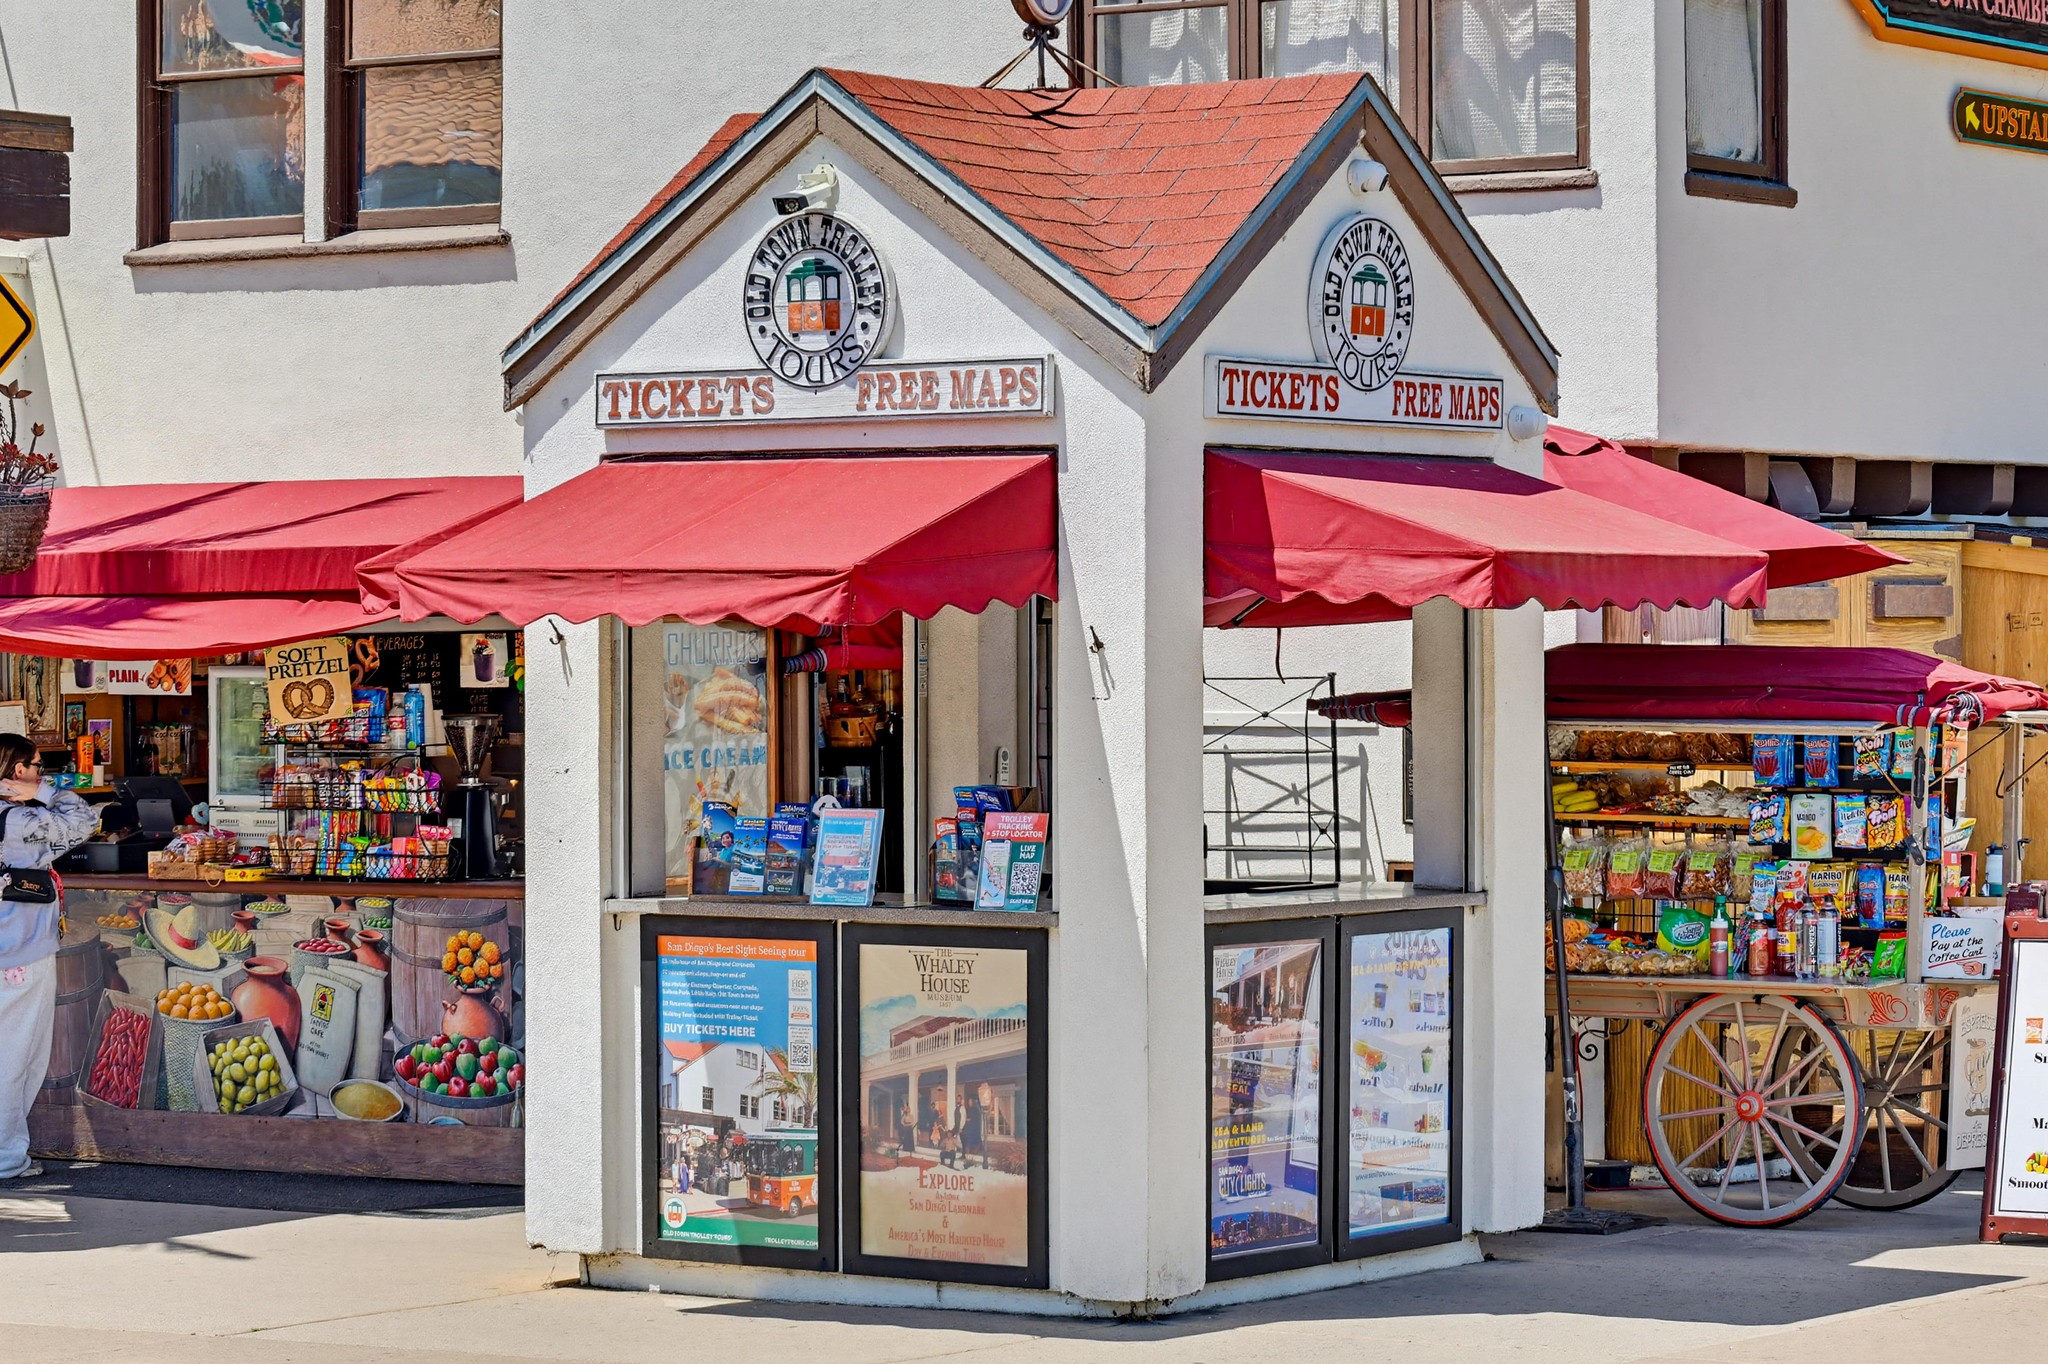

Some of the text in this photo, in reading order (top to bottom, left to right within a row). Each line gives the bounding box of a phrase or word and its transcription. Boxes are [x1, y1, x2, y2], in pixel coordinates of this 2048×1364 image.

[747, 217, 881, 318] OLD TOWN TROLLEY
[1324, 223, 1411, 326] OLD TOWN TROLLEY
[765, 332, 865, 384] TOURS
[1335, 332, 1399, 387] TOURS
[603, 366, 1038, 419] TICKETS FREE MAPS
[1222, 368, 1500, 421] TICKETS FREE MAPS
[376, 635, 424, 651] EVERAGES
[668, 630, 760, 666] CHURROS
[277, 646, 327, 665] SOFT
[109, 669, 139, 683] PLAIN
[268, 657, 348, 681] PRETZEL
[664, 750, 695, 771] ICE
[1000, 815, 1032, 823] TROLLEY
[1750, 802, 1780, 821] Trolli
[1868, 804, 1898, 826] Trolli
[991, 830, 1043, 838] STOP LOCATOR
[998, 823, 1033, 831] TRACKING
[1811, 872, 1842, 881] HARIBO
[1931, 923, 1971, 939] Please
[667, 942, 806, 958] San Diego's Best Sight Seeing tour
[1930, 937, 1983, 951] Pay at the
[935, 948, 952, 957] THE
[1928, 947, 1983, 963] Coffee Cart
[913, 954, 974, 974] WHALEY
[920, 974, 970, 993] HOUSE
[927, 993, 963, 1002] MUSEUM
[664, 1023, 756, 1037] BUY TICKETS HERE
[1214, 1122, 1264, 1137] SEA & LAND
[1212, 1134, 1267, 1149] ADVENTURES
[919, 1168, 974, 1191] EXPLORE
[1218, 1172, 1266, 1197] CITY LIGHTS
[925, 1200, 947, 1213] DIEGO
[942, 1216, 949, 1228] &
[690, 1232, 714, 1240] TROLLEY
[927, 1230, 946, 1244] MOST
